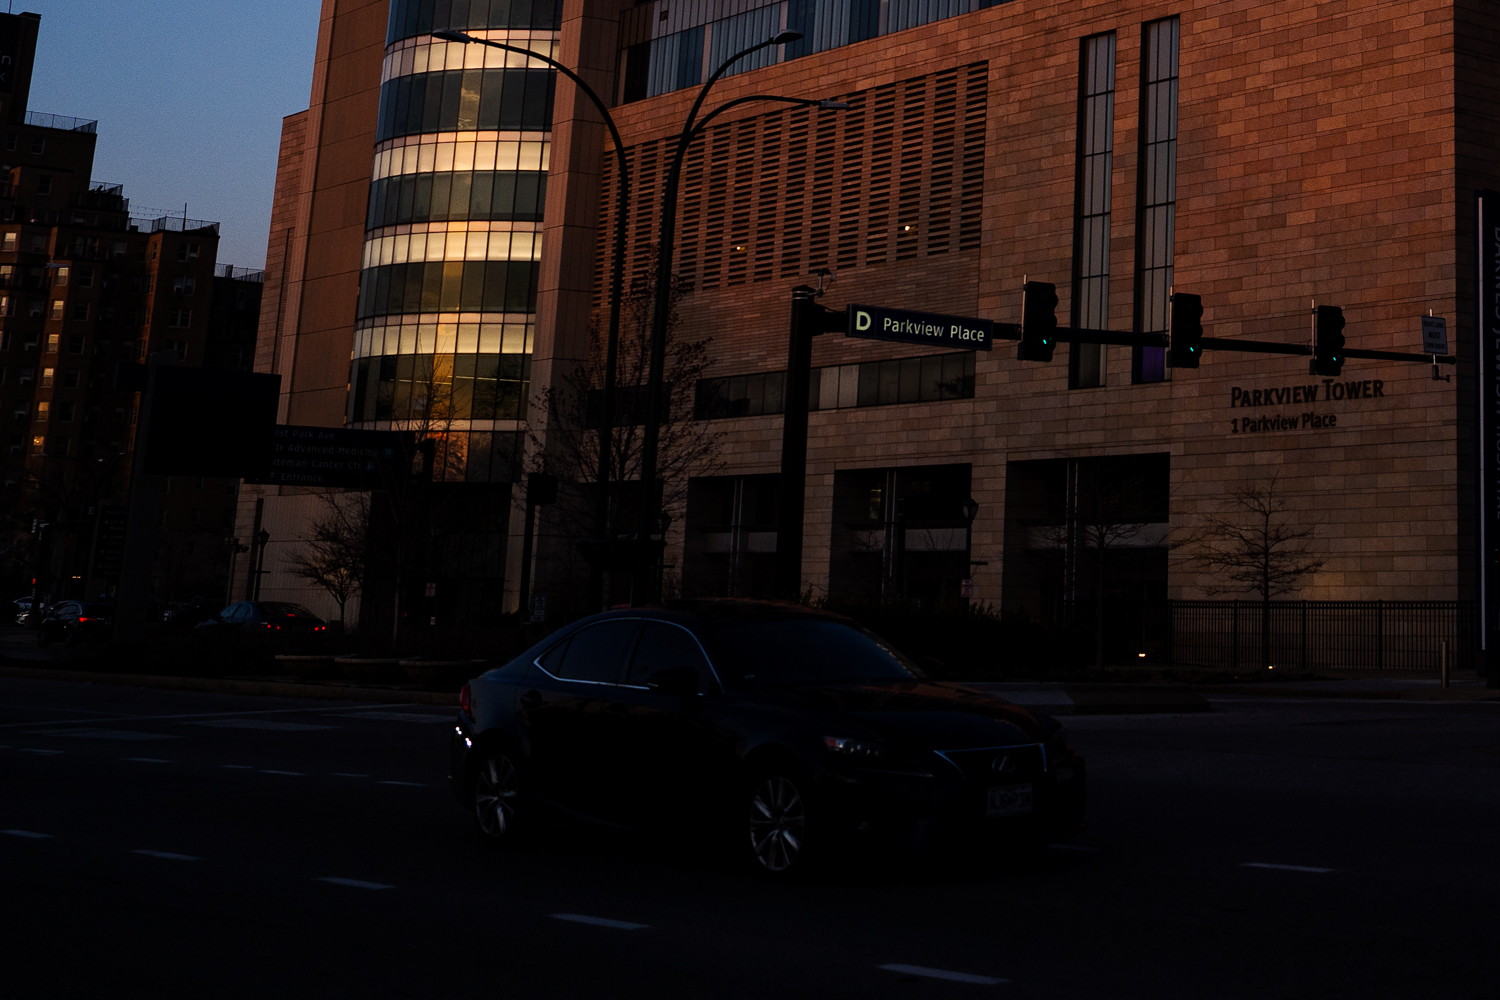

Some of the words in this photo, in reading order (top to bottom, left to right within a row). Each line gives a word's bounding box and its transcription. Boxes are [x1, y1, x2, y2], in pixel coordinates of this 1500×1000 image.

[855, 310, 872, 332] D
[883, 317, 945, 338] Parkview
[949, 324, 985, 342] Place
[1428, 331, 1441, 340] MUST
[1231, 384, 1318, 408] PARKVIEW
[1322, 378, 1384, 401] TOWER
[1231, 418, 1239, 433] 1
[1242, 414, 1299, 433] Parkview
[1302, 412, 1337, 429] Place
[292, 429, 314, 439] Park
[317, 430, 335, 440] Ave
[272, 443, 284, 452] tr
[287, 443, 334, 455] Advanced
[271, 457, 307, 468] iteman
[311, 459, 344, 469] Cancer
[281, 472, 324, 482] Entrance
[87, 506, 96, 515] E
